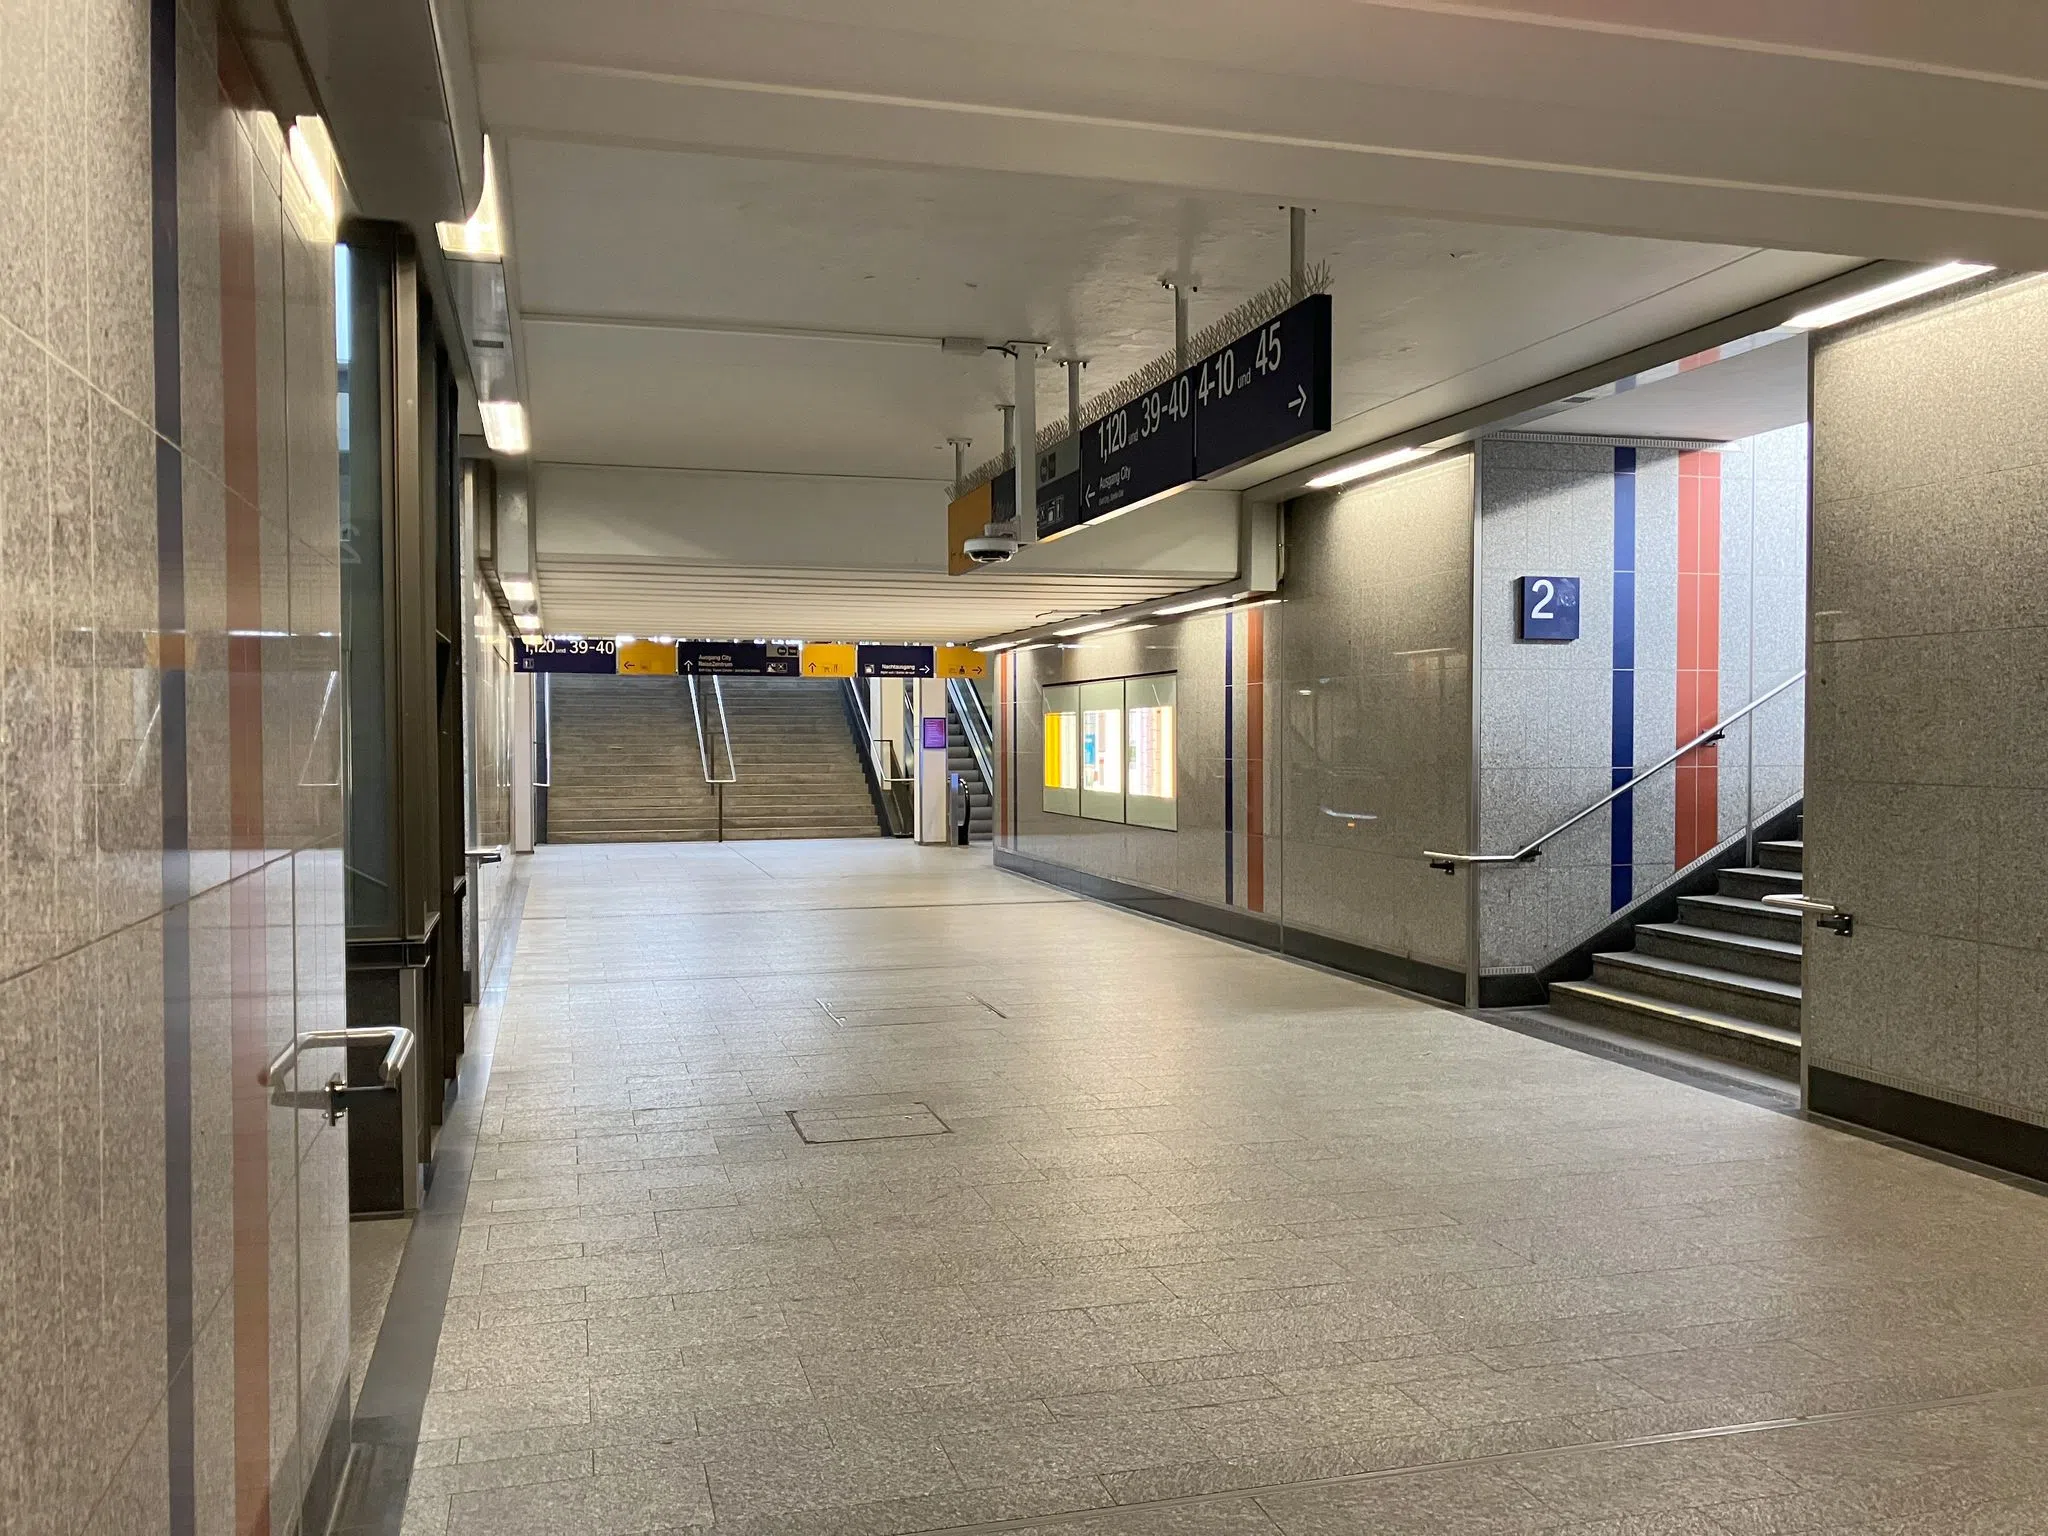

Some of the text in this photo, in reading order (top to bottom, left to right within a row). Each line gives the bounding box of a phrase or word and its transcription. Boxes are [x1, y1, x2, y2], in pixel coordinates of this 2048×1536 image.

[1198, 320, 1282, 406] 4-10 und 45
[1141, 375, 1189, 437] 39-40
[1120, 465, 1131, 481] City
[1531, 579, 1555, 619] 2
[569, 640, 615, 655] 39-40
